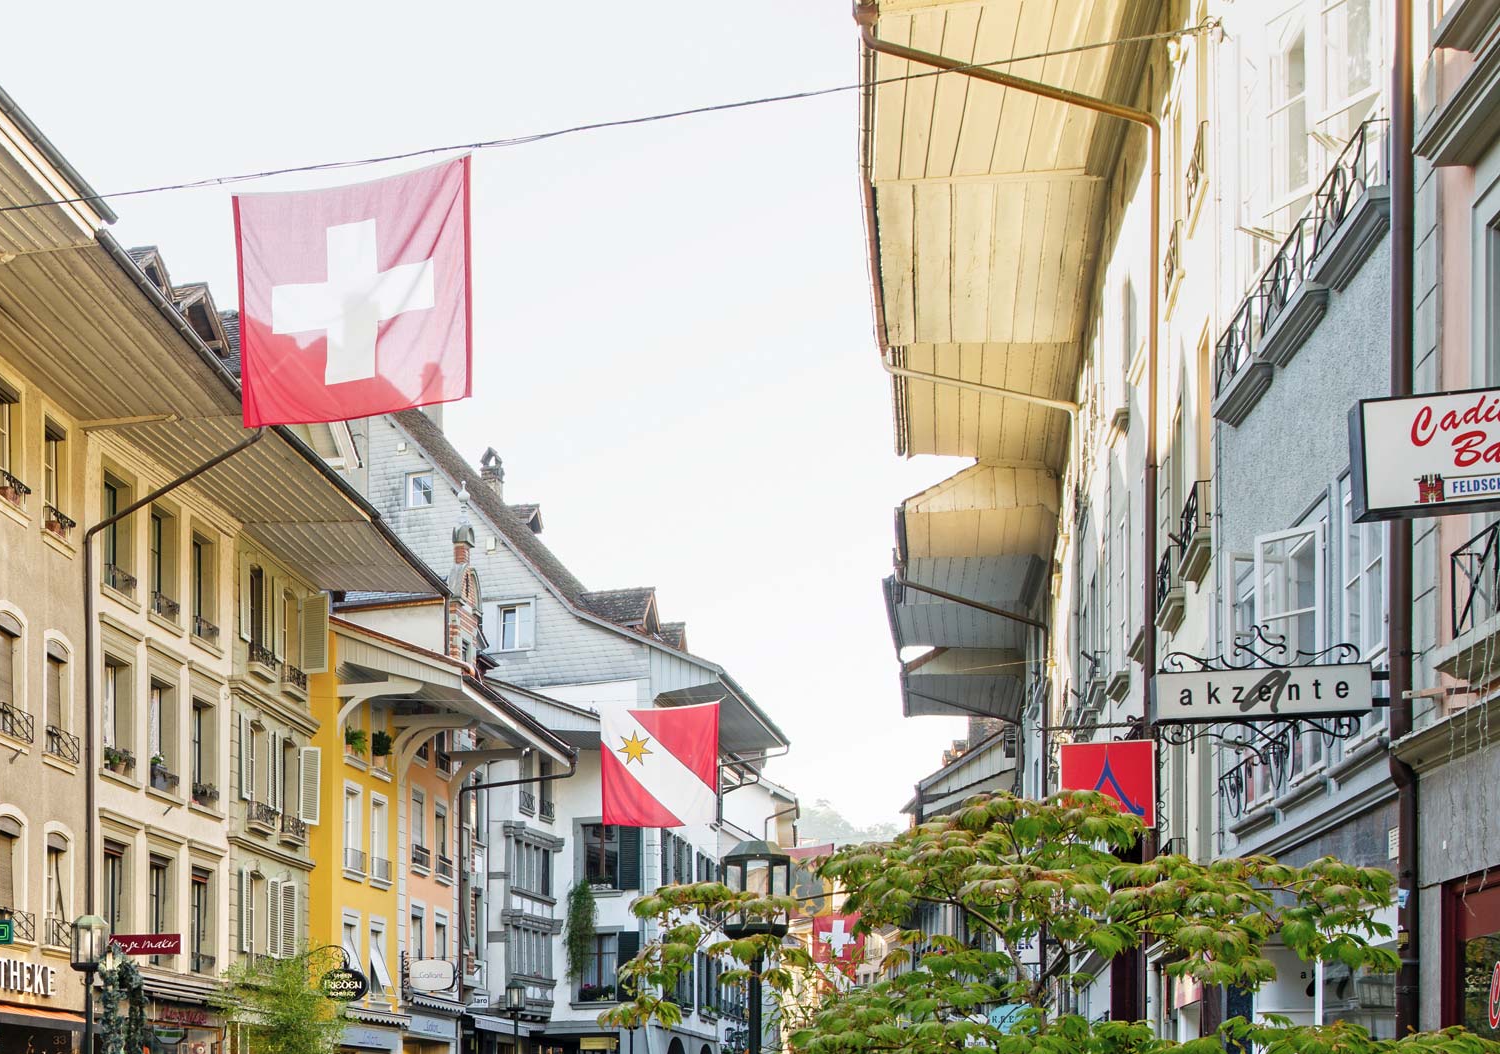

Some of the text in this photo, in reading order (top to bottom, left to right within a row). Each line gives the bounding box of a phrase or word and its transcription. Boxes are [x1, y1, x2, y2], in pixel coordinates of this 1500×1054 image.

[1411, 394, 1500, 447] Cadi
[1451, 430, 1500, 467] Ba
[1452, 477, 1500, 494] FELDSCH
[1179, 679, 1349, 706] akzente
[142, 938, 179, 949] maker
[52, 1036, 67, 1045] 33
